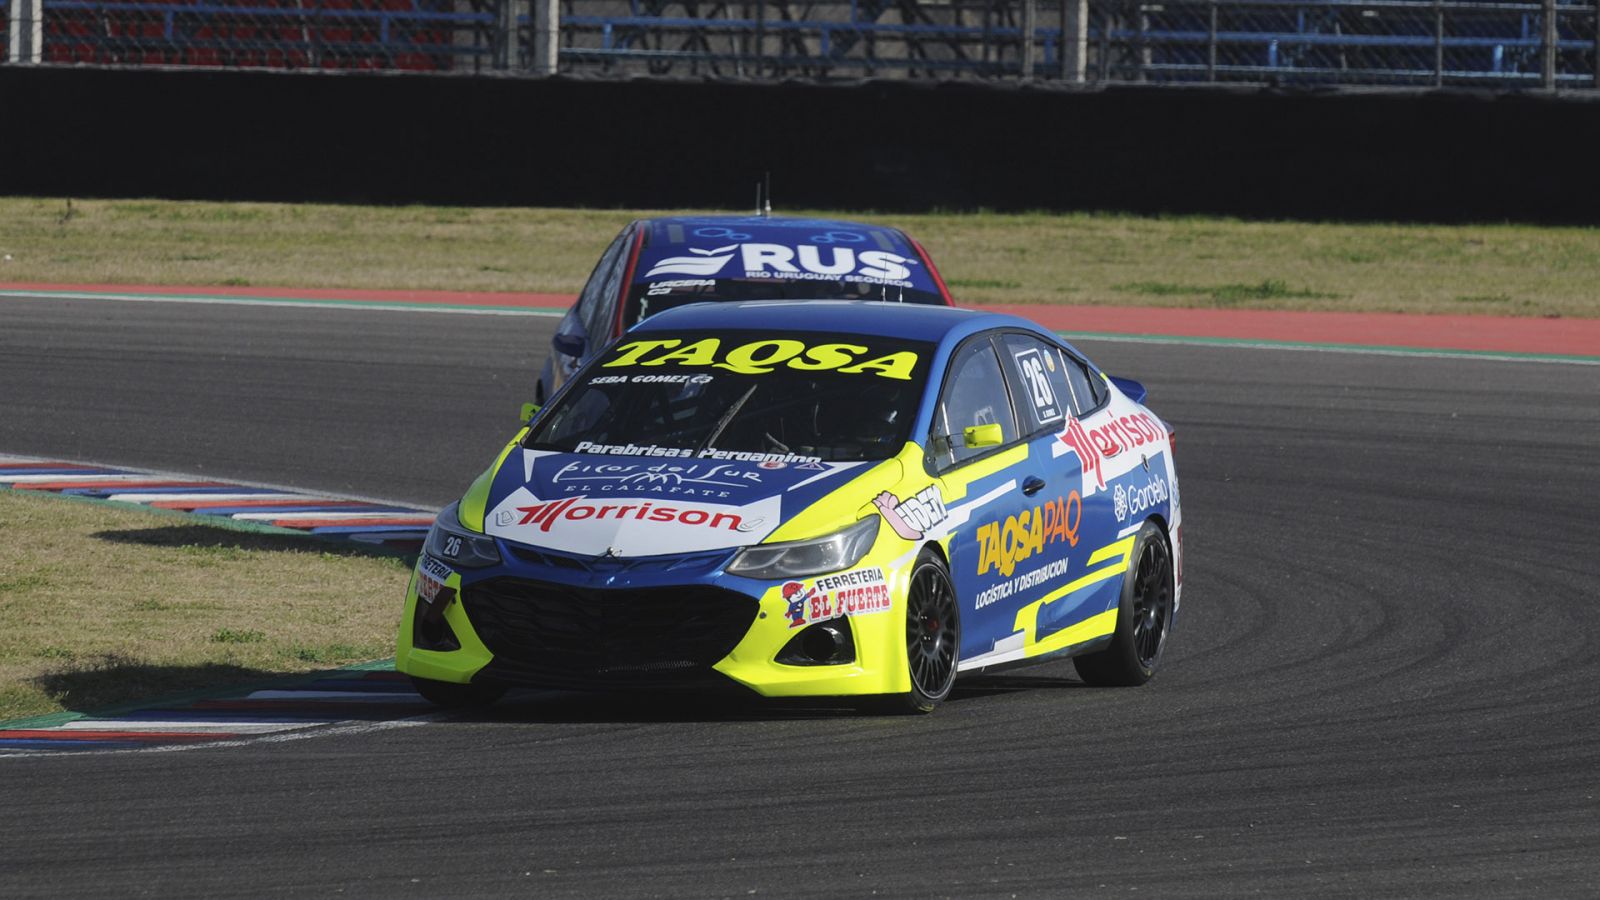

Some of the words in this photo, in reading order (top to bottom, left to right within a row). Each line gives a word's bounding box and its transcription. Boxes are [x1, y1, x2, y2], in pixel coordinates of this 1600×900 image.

[741, 243, 911, 280] RUS
[745, 271, 774, 279] RIO
[775, 271, 843, 283] URUGUAY
[845, 274, 914, 288] SEGUROS
[601, 338, 918, 381] TAQSA
[587, 375, 628, 386] SEBA
[631, 374, 690, 384] GOMEZ
[1022, 357, 1054, 408] 26
[574, 441, 694, 457] Parabrisas
[602, 485, 731, 498] CALAFATE
[516, 494, 741, 532] Morrison
[443, 536, 463, 557] 26
[816, 568, 884, 592] FERRETERIA
[975, 581, 1013, 610] LOGÍSTICA
[1013, 580, 1020, 593] Y
[1019, 557, 1068, 592] DISTRIBUCION
[810, 595, 832, 618] EL
[836, 584, 891, 615] FUERTE
